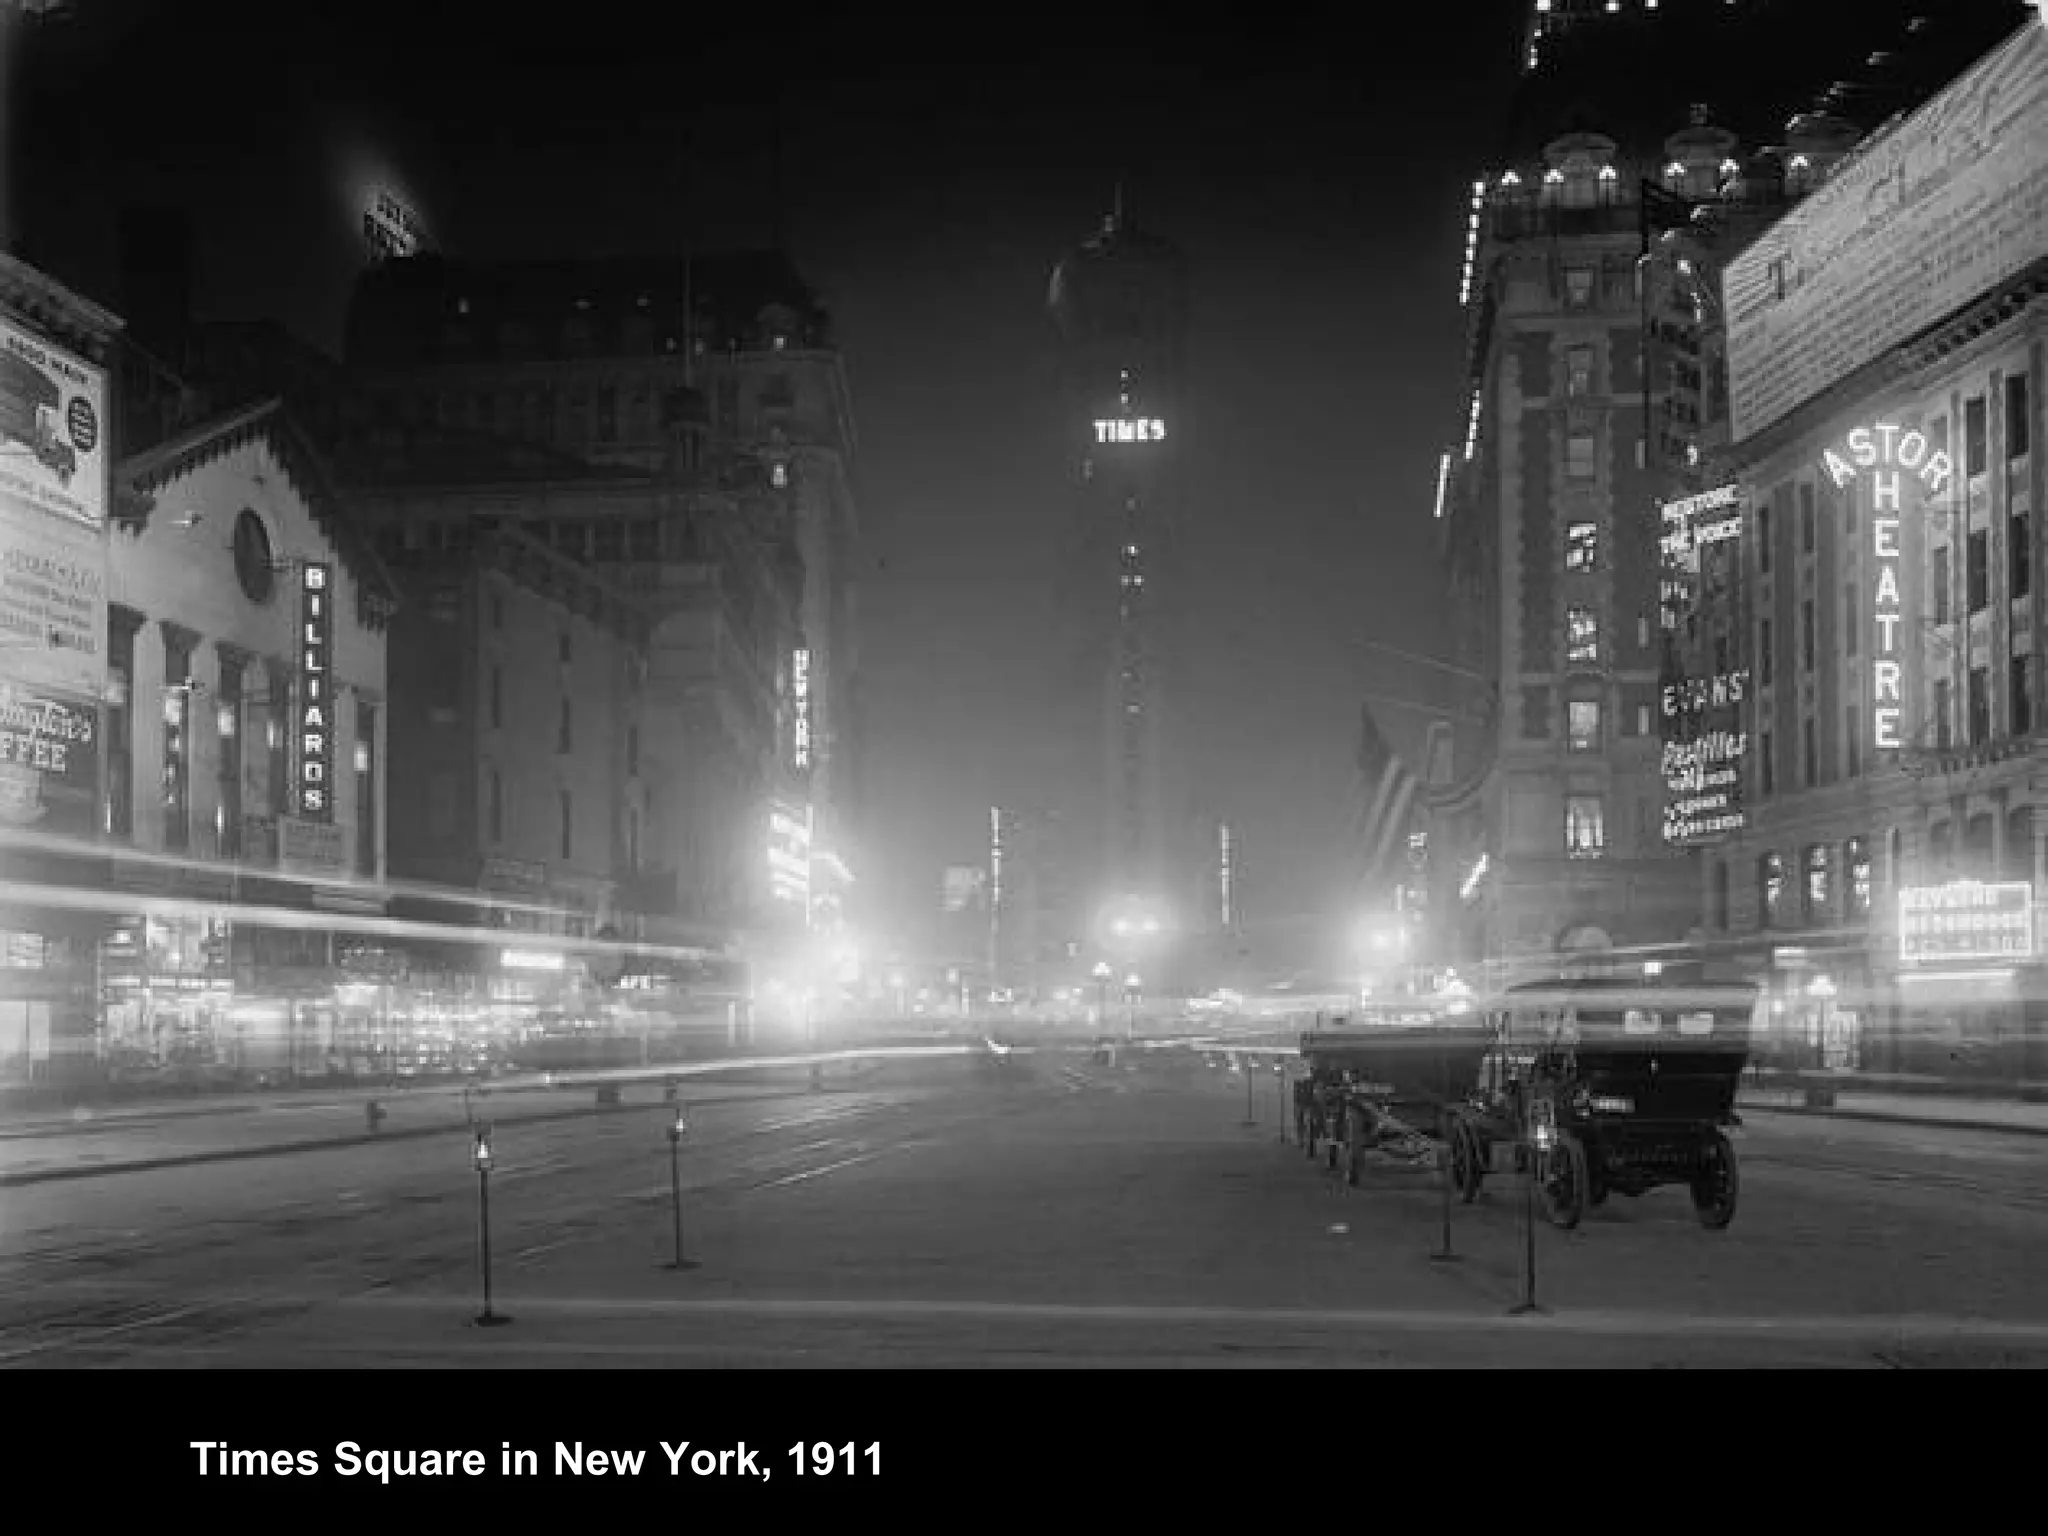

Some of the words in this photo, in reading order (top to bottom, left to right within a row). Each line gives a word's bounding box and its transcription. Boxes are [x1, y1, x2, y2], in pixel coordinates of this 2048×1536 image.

[1092, 417, 1165, 442] TIMES
[1822, 422, 1951, 490] ASTOR
[304, 567, 326, 811] BILLIARDS
